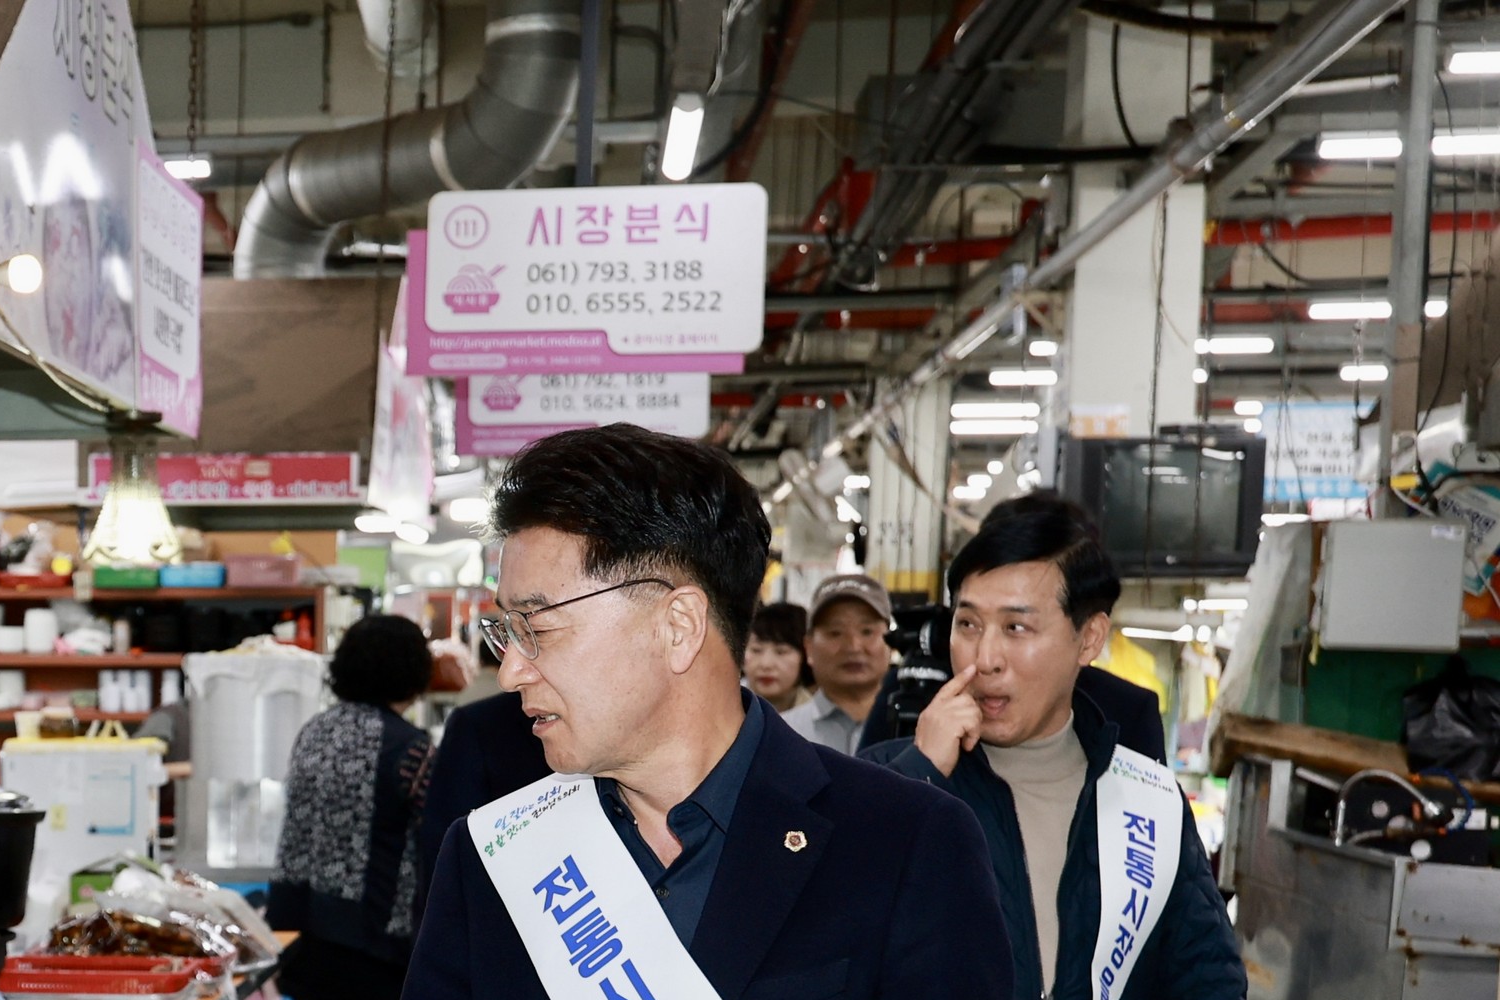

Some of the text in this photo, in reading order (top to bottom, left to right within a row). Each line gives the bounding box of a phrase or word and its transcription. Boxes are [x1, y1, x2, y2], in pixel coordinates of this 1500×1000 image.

[527, 203, 711, 247] 시장분식
[526, 262, 579, 285] 061)
[643, 260, 703, 282] 3188
[661, 290, 722, 313] 2522
[537, 784, 562, 805] 의회
